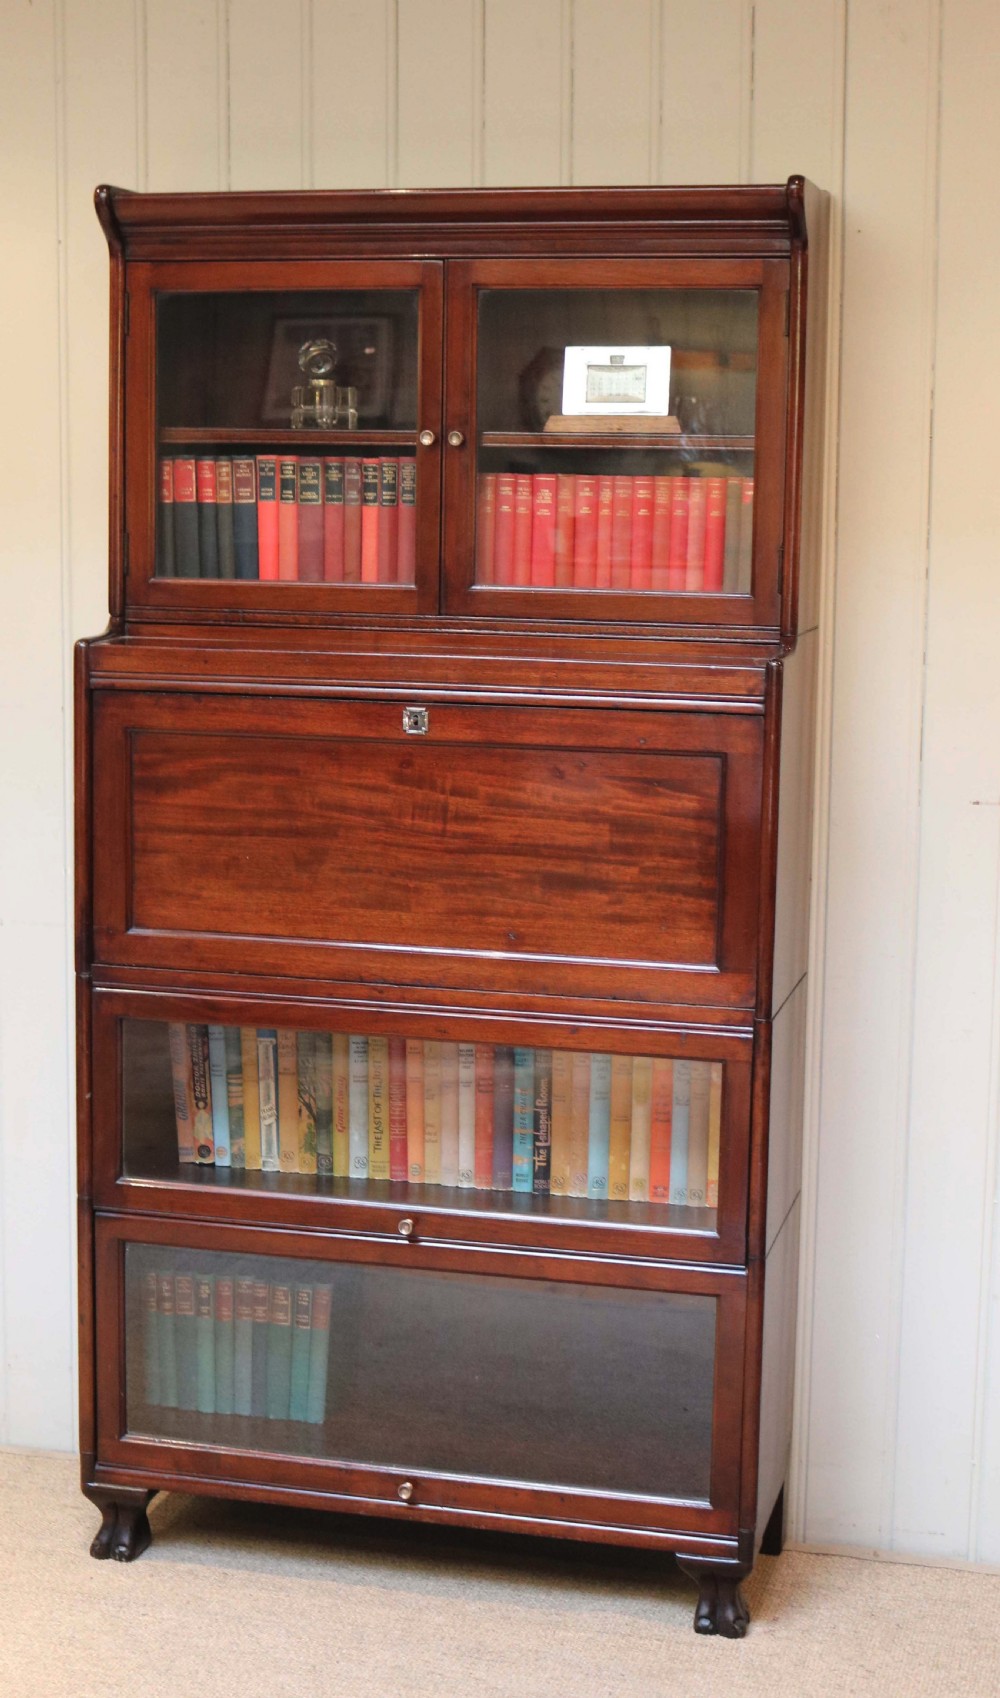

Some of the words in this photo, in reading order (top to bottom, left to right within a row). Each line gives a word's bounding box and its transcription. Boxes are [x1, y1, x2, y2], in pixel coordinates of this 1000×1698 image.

[373, 1059, 383, 1081] JUST
[194, 1064, 202, 1098] DOCTOR
[373, 1081, 382, 1102] THE
[536, 1077, 548, 1107] Room
[373, 1102, 382, 1114] OF
[336, 1106, 347, 1133] Gone
[373, 1116, 383, 1135] LAST
[520, 1116, 528, 1130] SEA
[390, 1120, 406, 1142] THE
[519, 1132, 528, 1145] THE
[373, 1135, 382, 1154] THE
[533, 1147, 547, 1172] The
